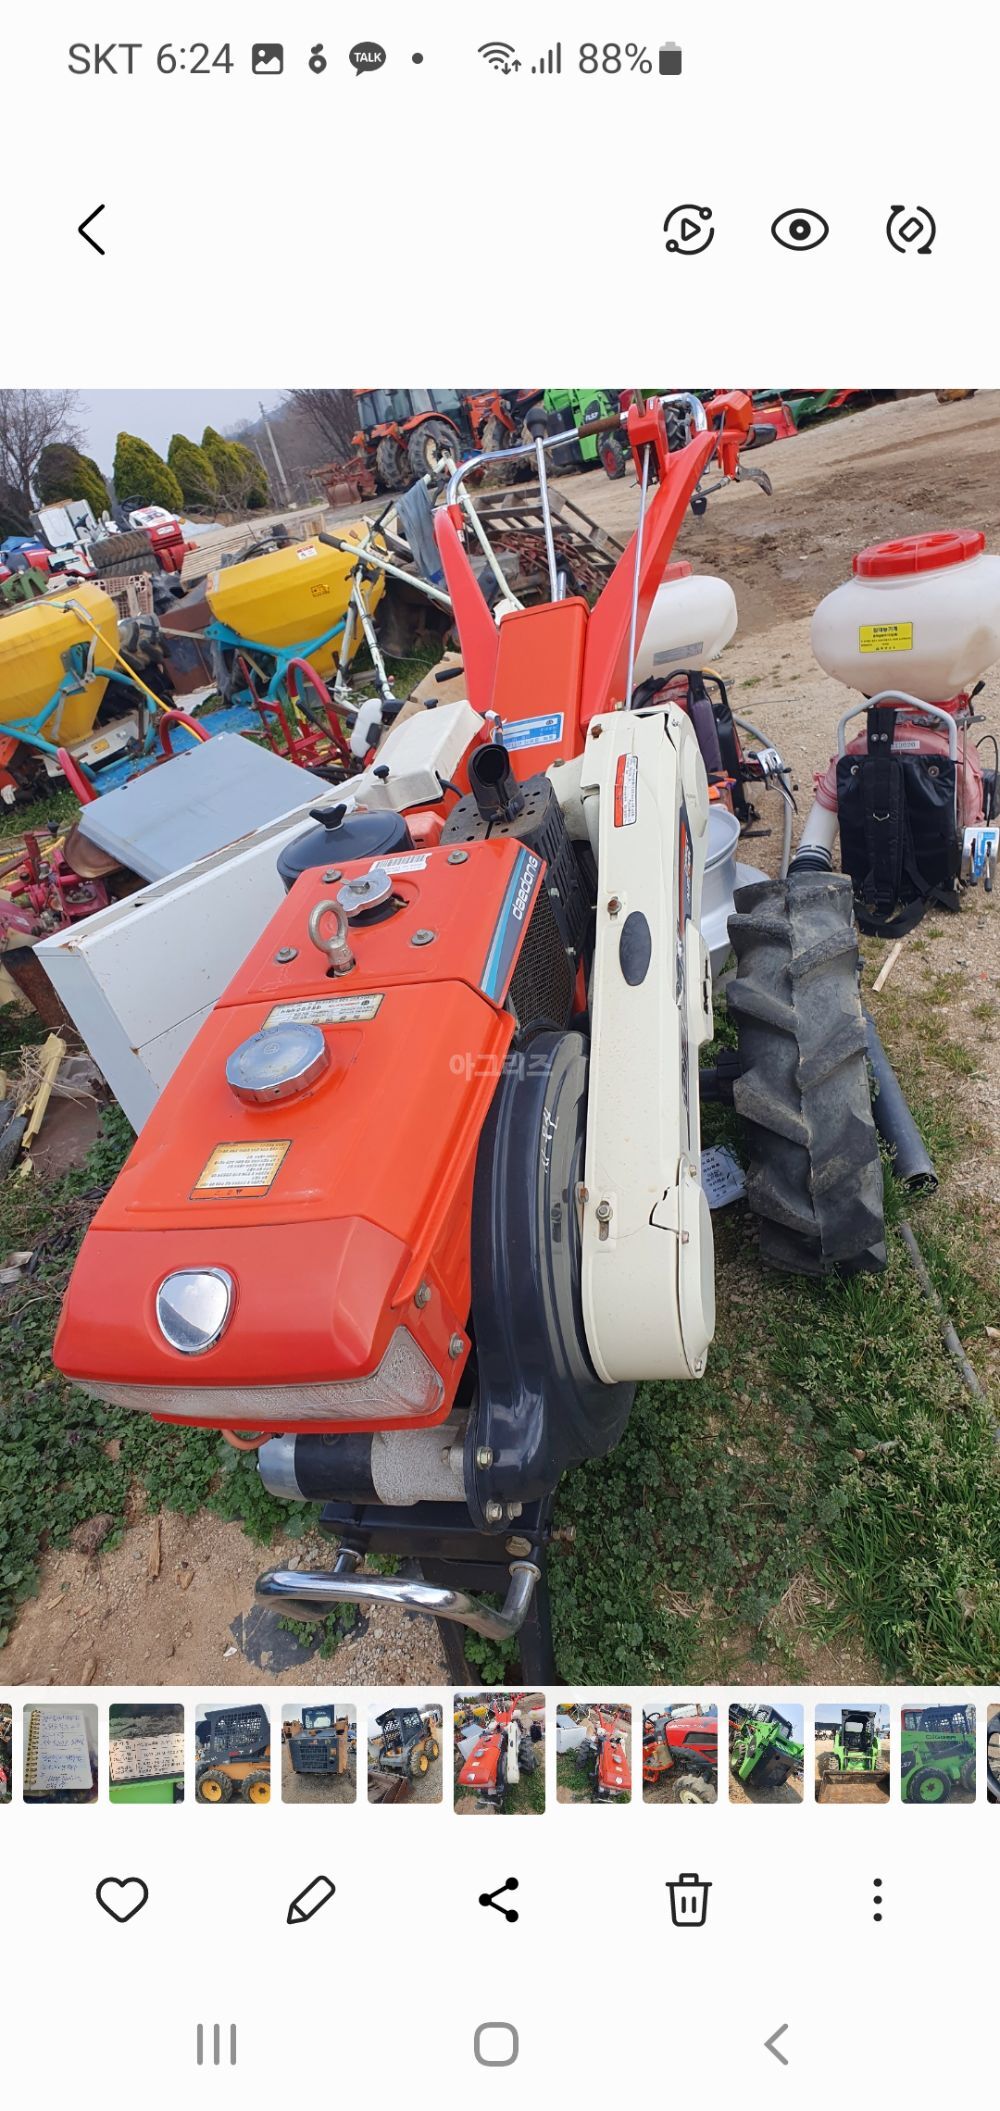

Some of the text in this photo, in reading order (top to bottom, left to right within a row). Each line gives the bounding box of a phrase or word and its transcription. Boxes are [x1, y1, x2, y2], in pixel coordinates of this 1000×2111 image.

[68, 43, 234, 74] SKT 6:24
[353, 52, 382, 63] TALK
[579, 42, 653, 74] 88%
